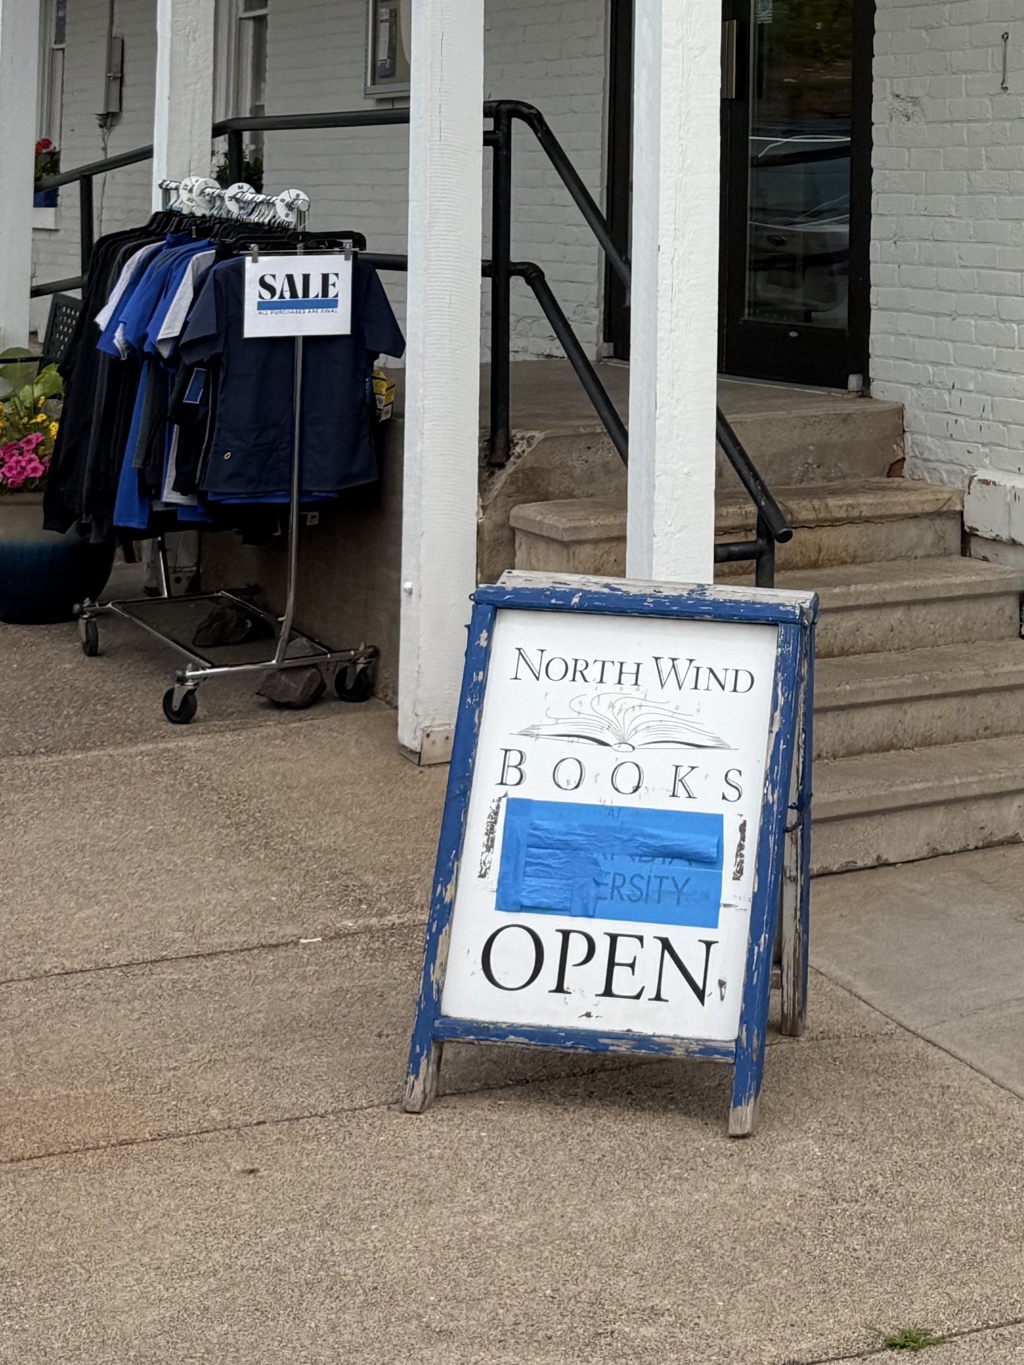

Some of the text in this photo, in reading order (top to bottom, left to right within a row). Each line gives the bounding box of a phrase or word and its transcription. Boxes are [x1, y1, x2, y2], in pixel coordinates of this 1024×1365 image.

[258, 272, 339, 301] SALE
[510, 647, 756, 695] NORTH WIND
[494, 747, 745, 803] BOOKS
[480, 922, 720, 1007] OPEN
